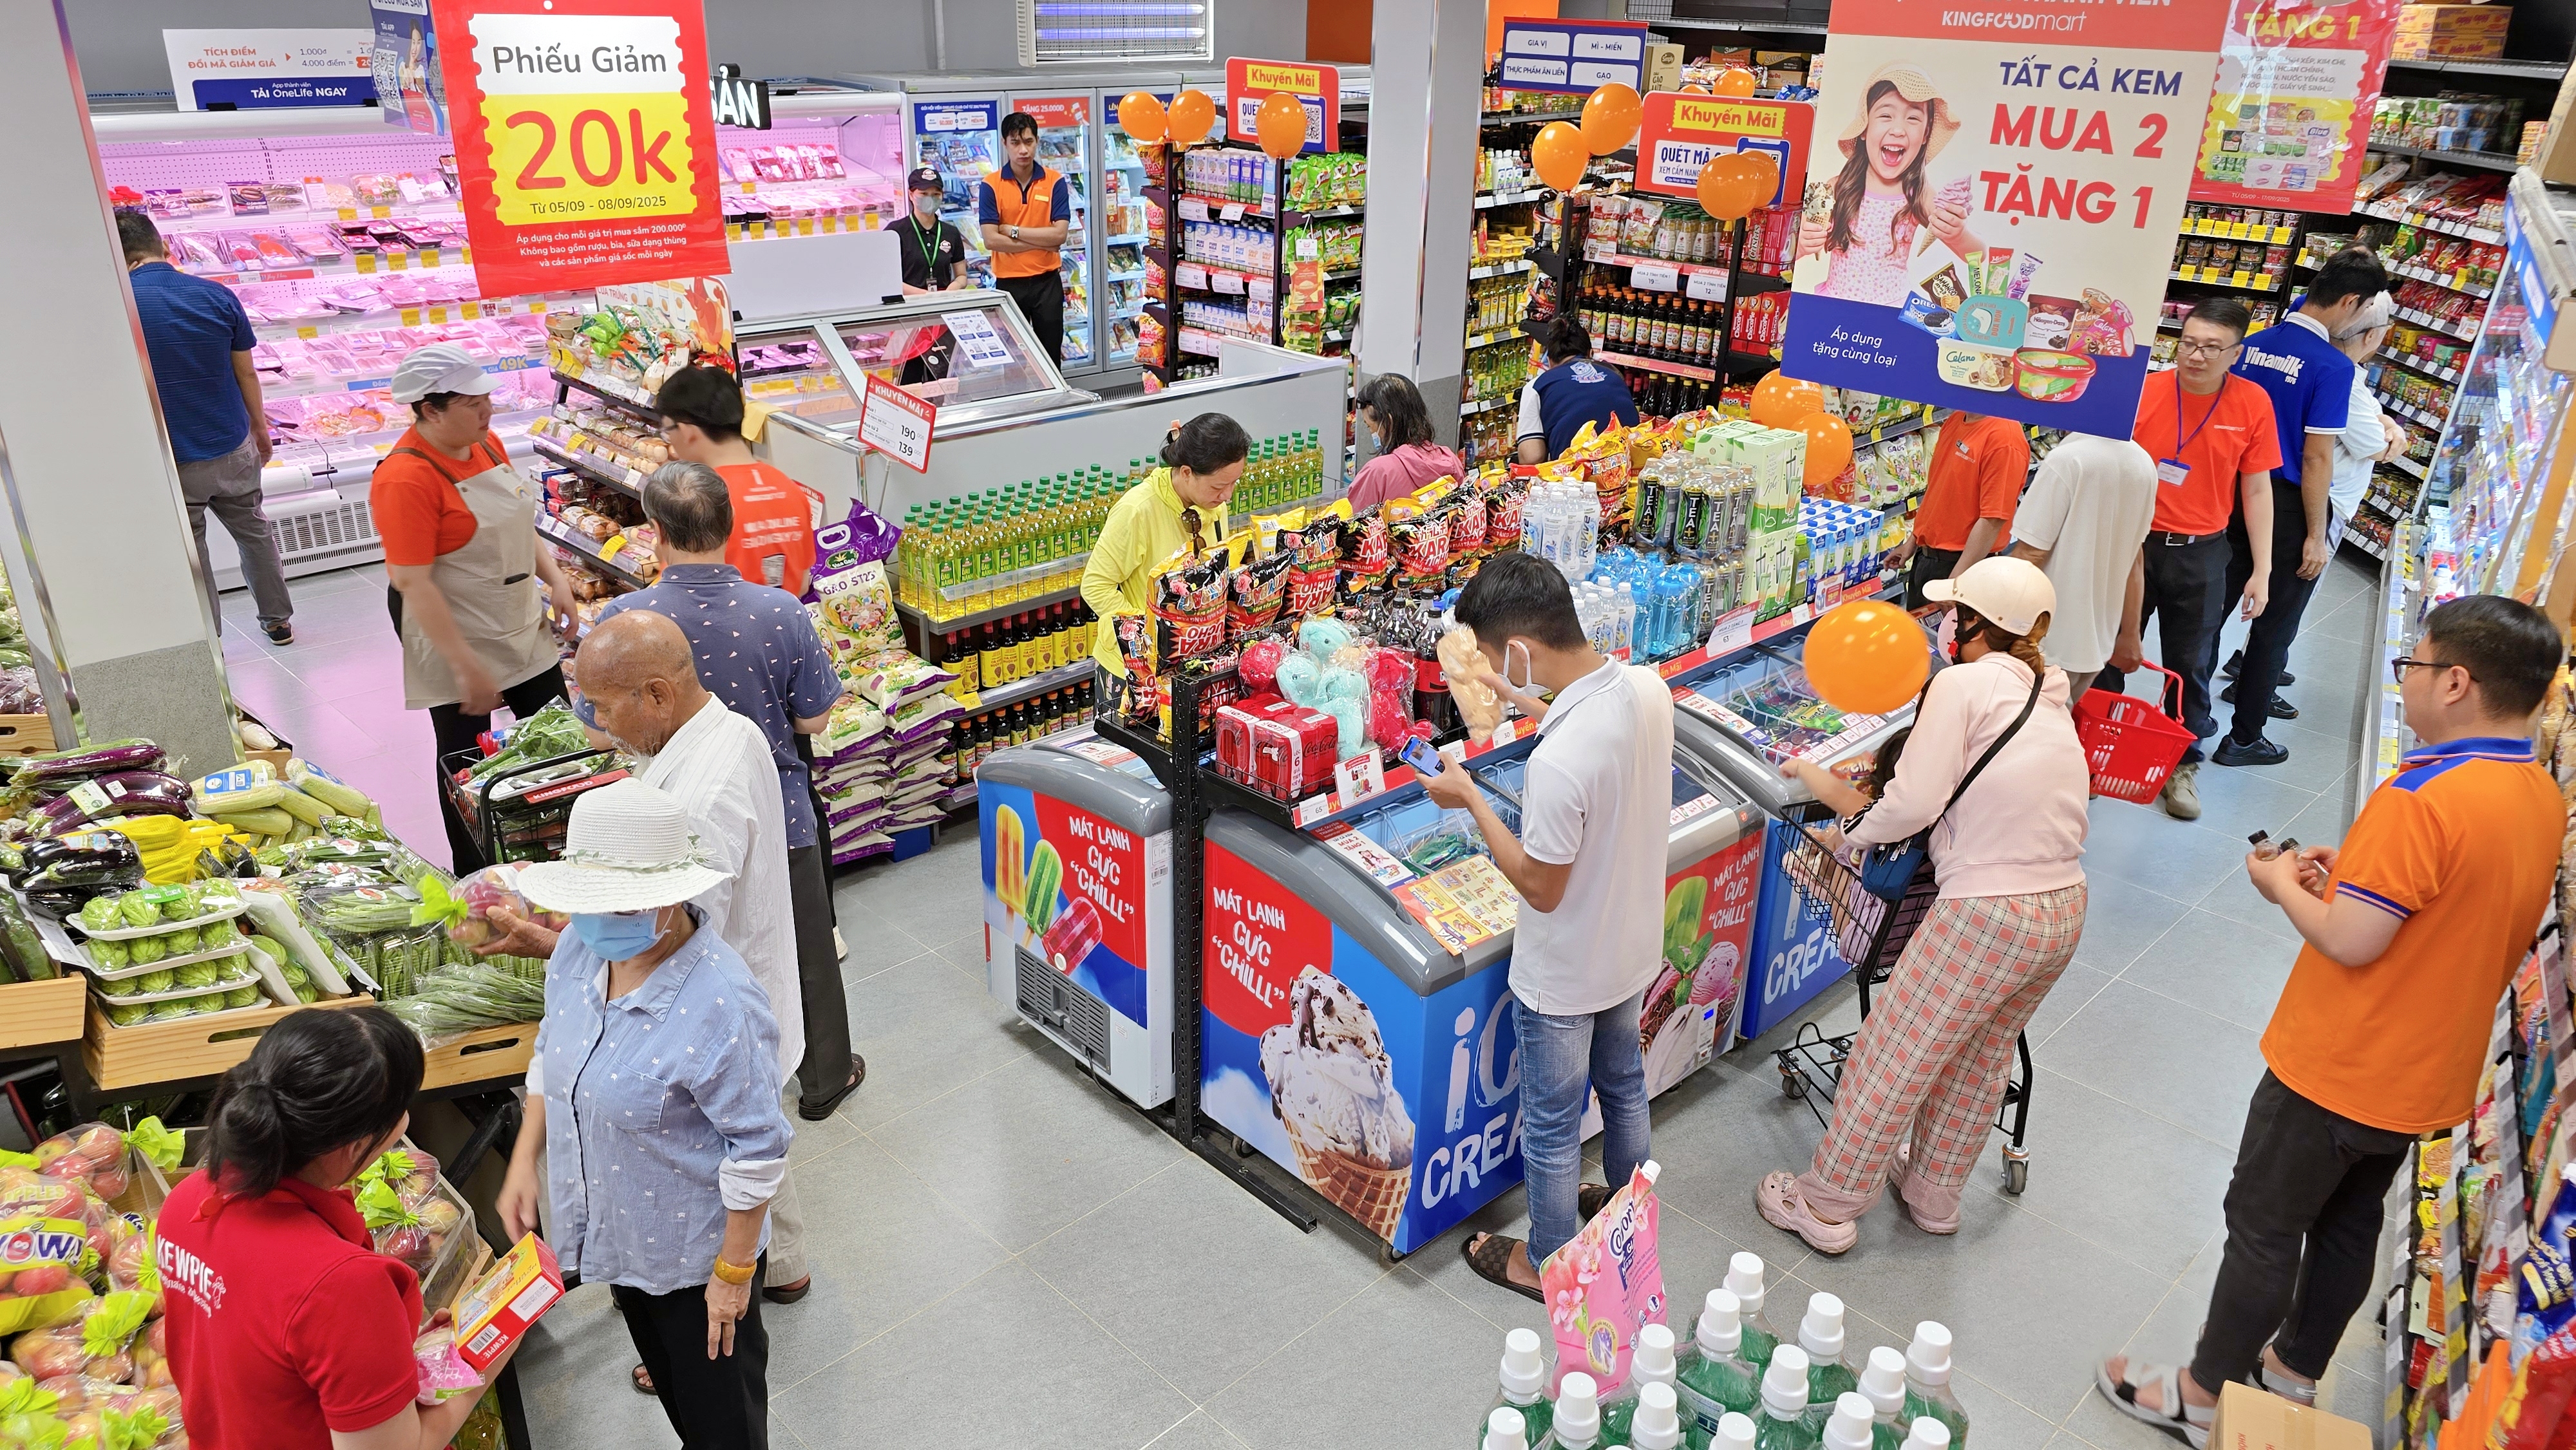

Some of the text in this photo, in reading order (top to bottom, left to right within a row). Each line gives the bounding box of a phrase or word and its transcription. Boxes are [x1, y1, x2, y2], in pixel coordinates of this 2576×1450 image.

[2346, 15, 2362, 41] 1
[204, 46, 256, 56] TÍCH ĐIỂM
[1540, 40, 1547, 49] VỊ
[1591, 42, 1599, 50] MÌ
[210, 59, 225, 68] MÃ
[227, 59, 256, 68] GIẢM
[258, 59, 276, 68] GIÁ
[493, 43, 667, 74] Phiếu Giảm
[1252, 68, 1315, 88] Khuyến Mãi
[1506, 66, 1522, 75] THỰC
[1596, 71, 1611, 81] GẠO
[2000, 55, 2183, 97] TẤT CẢ KEM
[251, 87, 348, 99] TẢI OneLife NGAY
[1242, 101, 1260, 116] QUÉ
[1680, 105, 1777, 129] Khuyến Mãi
[1989, 104, 2168, 159] MUA 2
[2308, 127, 2329, 137] Blue
[506, 109, 677, 191] 20k
[1661, 145, 1710, 165] QUÉT MÃ
[1659, 165, 1671, 174] XEM
[530, 196, 667, 214] Từ 05/09 08/09/2025
[1980, 163, 2154, 229] TẶNG 1
[516, 233, 529, 245] Áp
[531, 232, 553, 244] dụng
[554, 231, 569, 241] cho
[571, 228, 587, 240] mỗi
[589, 229, 601, 240] giá
[602, 229, 612, 238] trị
[614, 227, 632, 236] mua
[633, 225, 650, 236] sắm
[520, 244, 549, 256] Không
[550, 243, 566, 254] bao
[569, 241, 587, 254] gồm
[627, 238, 641, 249] sữa
[642, 236, 663, 249] dạng
[664, 234, 687, 246] thùng
[1748, 224, 1761, 260] Custas
[539, 249, 673, 268] và các sản phẩm giá sốc mỗi ngày
[1973, 266, 1982, 296] MELONA
[1911, 297, 1937, 310] OREO
[1830, 325, 1884, 350] Áp dụng
[498, 355, 529, 372] 49K
[1812, 341, 1897, 368] tặng cùng loại
[1946, 350, 1976, 364] Celano
[2245, 346, 2305, 377] Vinamilk
[875, 384, 924, 417] KHUYẾN MÃI
[1722, 397, 1739, 406] Tipo
[901, 425, 916, 440] 190
[899, 441, 913, 457] 139
[1841, 583, 1872, 603] Khuyến Mãi
[1779, 617, 1794, 628] Khu
[1294, 757, 1300, 767] 6
[1069, 816, 1131, 852] MÁT LẠNH
[1337, 838, 1352, 847] MUA
[1088, 845, 1121, 886] CỰC
[1714, 845, 1759, 892] MÁT LẠNH
[1725, 876, 1748, 905] CỰC
[1213, 887, 1286, 932] MÁT LẠNH
[1233, 920, 1271, 967] CỰC
[1763, 927, 1841, 1005] CREA
[156, 1234, 214, 1301] KEWPIE
[484, 1333, 509, 1360] KEWPIE
